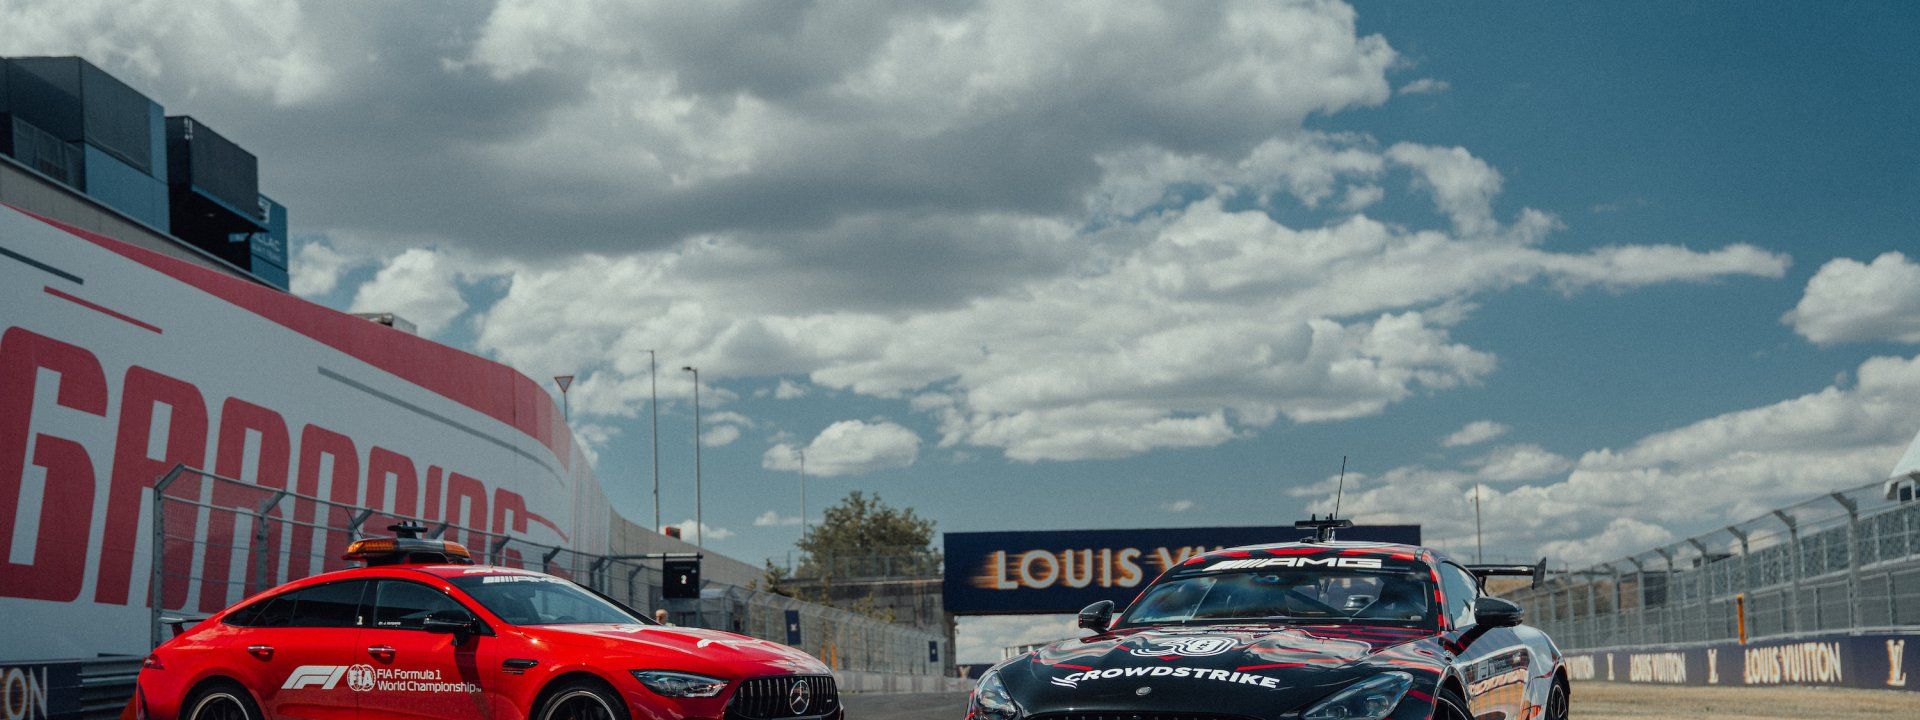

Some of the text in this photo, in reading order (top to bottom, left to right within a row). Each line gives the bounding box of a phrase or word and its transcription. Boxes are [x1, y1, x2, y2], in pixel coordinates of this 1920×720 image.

[997, 548, 1143, 589] LOUIS
[1256, 557, 1382, 569] AMG
[377, 668, 441, 680] FIA Formula 1
[1744, 641, 1842, 684] LOUIS VUITTON
[281, 665, 349, 689] F1
[349, 668, 373, 687] FIA
[377, 681, 406, 691] World
[1064, 666, 1281, 689] CROWDSTRIKE
[0, 667, 48, 720] ON
